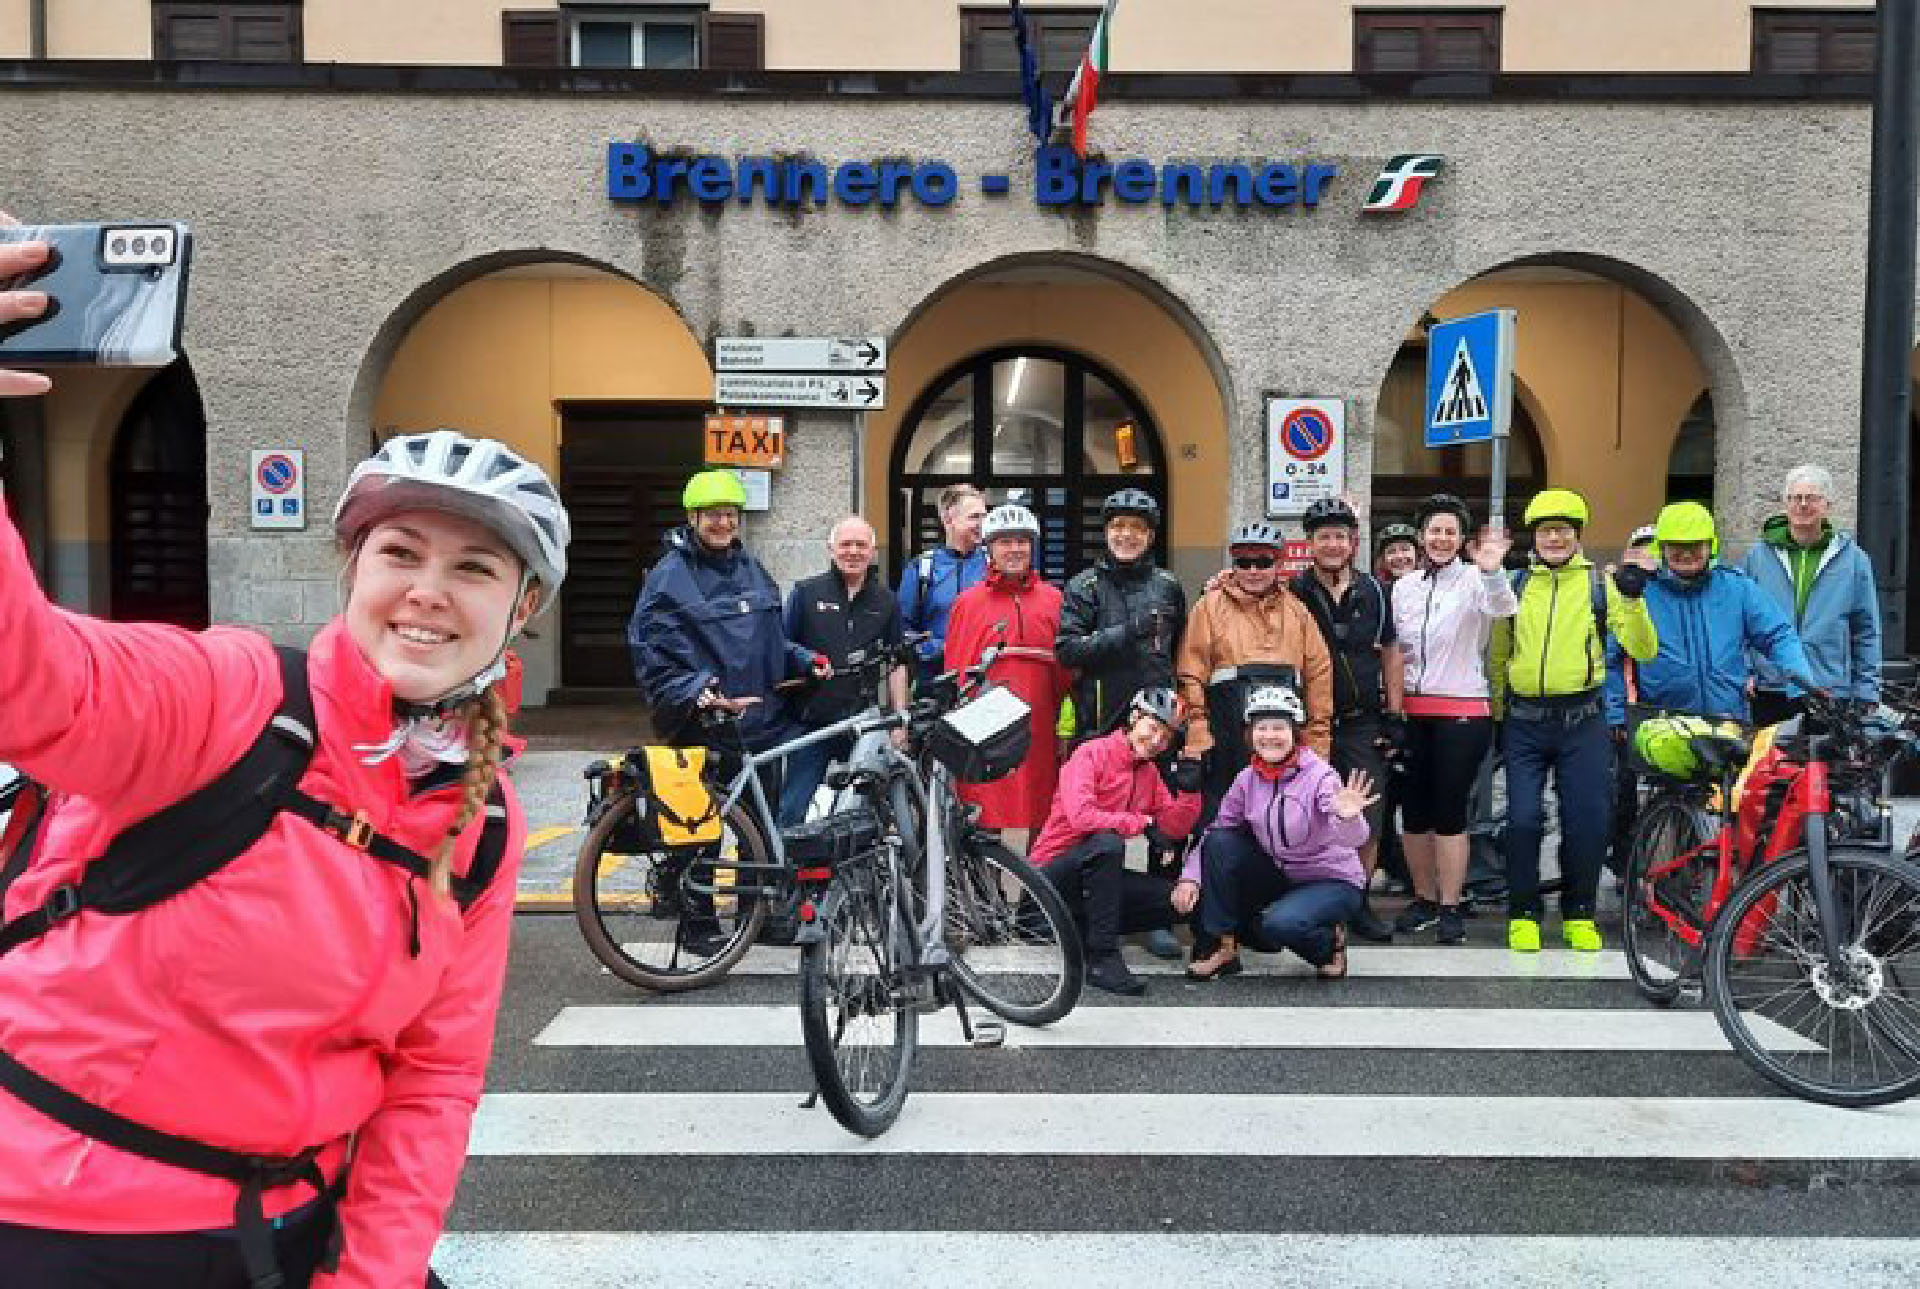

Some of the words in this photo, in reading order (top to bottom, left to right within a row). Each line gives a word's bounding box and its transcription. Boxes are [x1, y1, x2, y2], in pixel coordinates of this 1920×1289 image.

[608, 142, 957, 207] Brennero
[981, 174, 1009, 194] -
[1036, 146, 1336, 208] Brenner
[709, 430, 780, 454] TAXI
